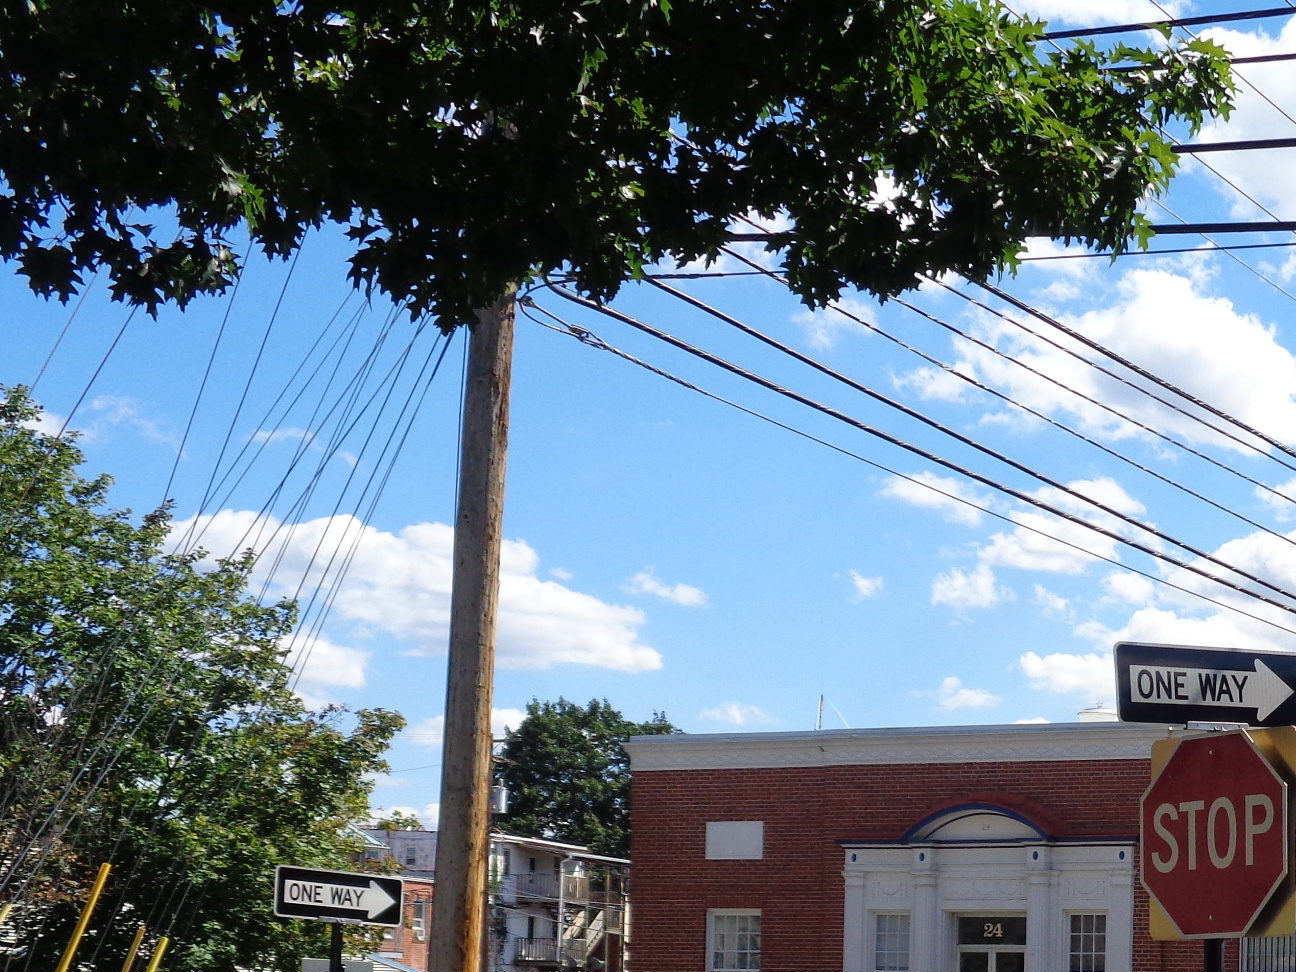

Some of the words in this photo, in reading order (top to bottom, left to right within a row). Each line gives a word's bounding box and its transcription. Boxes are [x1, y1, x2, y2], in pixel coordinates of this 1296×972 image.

[1137, 669, 1189, 700] ONE
[1197, 673, 1248, 703] WAY
[1151, 793, 1275, 874] STOP
[289, 883, 323, 903] ONE
[330, 887, 365, 907] WAY
[984, 923, 1003, 937] 24
